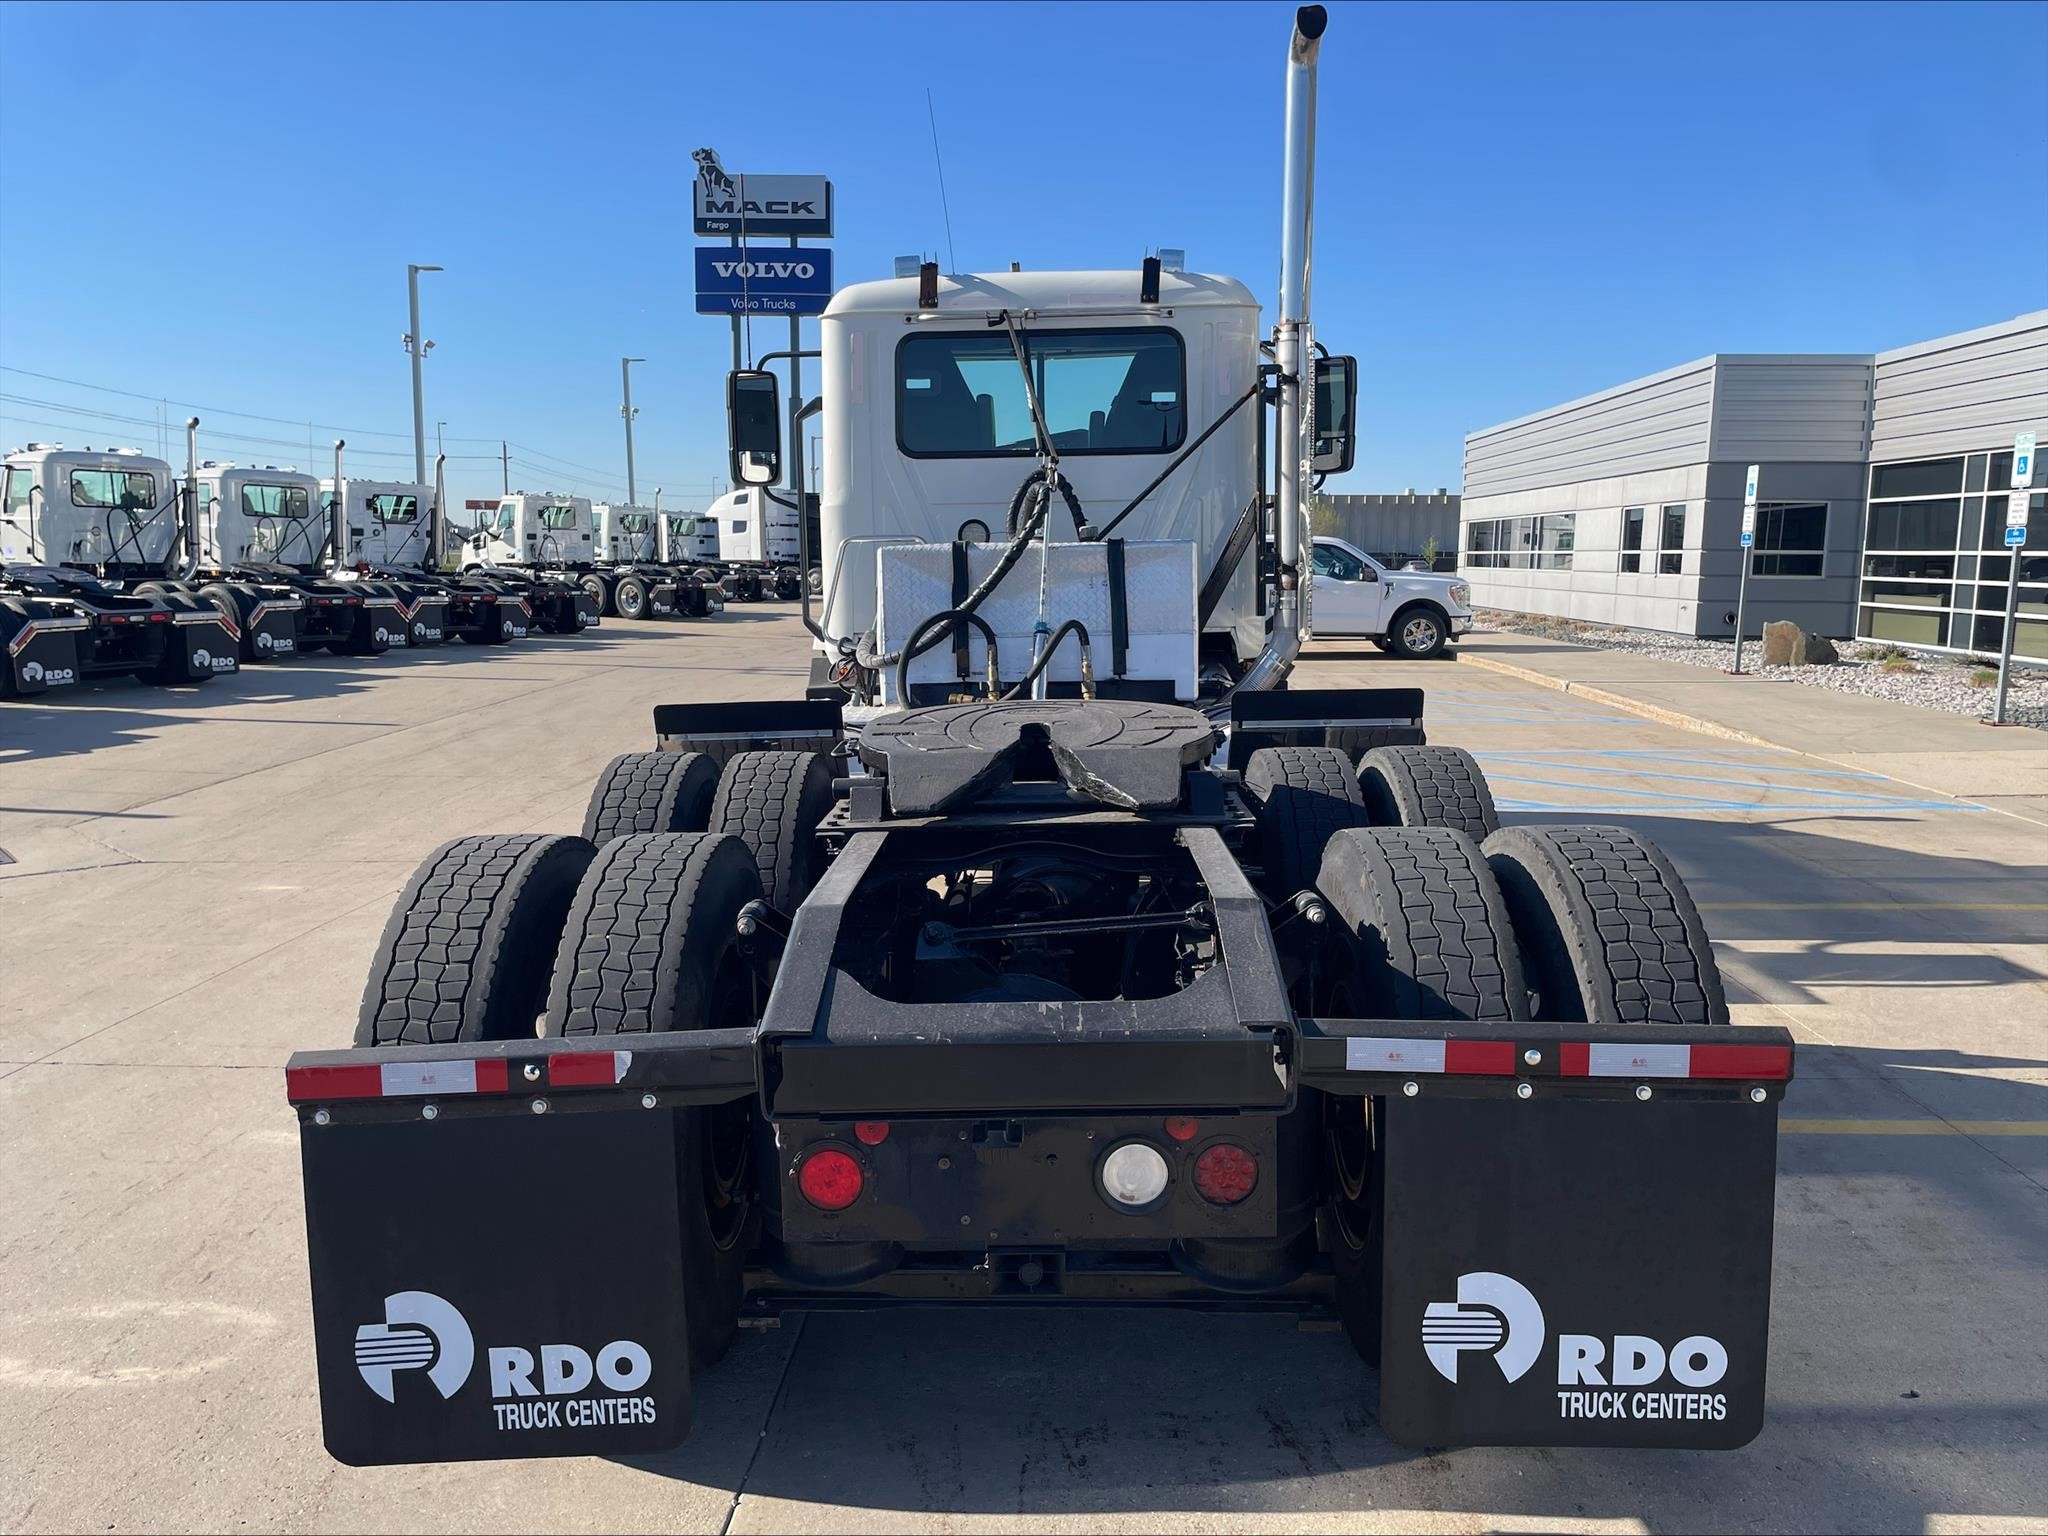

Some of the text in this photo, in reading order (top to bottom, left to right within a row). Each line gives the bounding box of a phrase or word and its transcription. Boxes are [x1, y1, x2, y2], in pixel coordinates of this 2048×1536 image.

[706, 200, 816, 214] MACK
[706, 221, 729, 230] Fargo
[711, 262, 815, 279] VOLVO
[730, 298, 796, 310] Vovo Trucks
[211, 657, 235, 667] RDO
[45, 668, 73, 680] RDO
[1557, 1334, 1729, 1388] RDO
[488, 1340, 652, 1398] RDO
[493, 1396, 656, 1431] TRUCK CENTERS
[1557, 1391, 1727, 1421] TRUCK CENTERS
